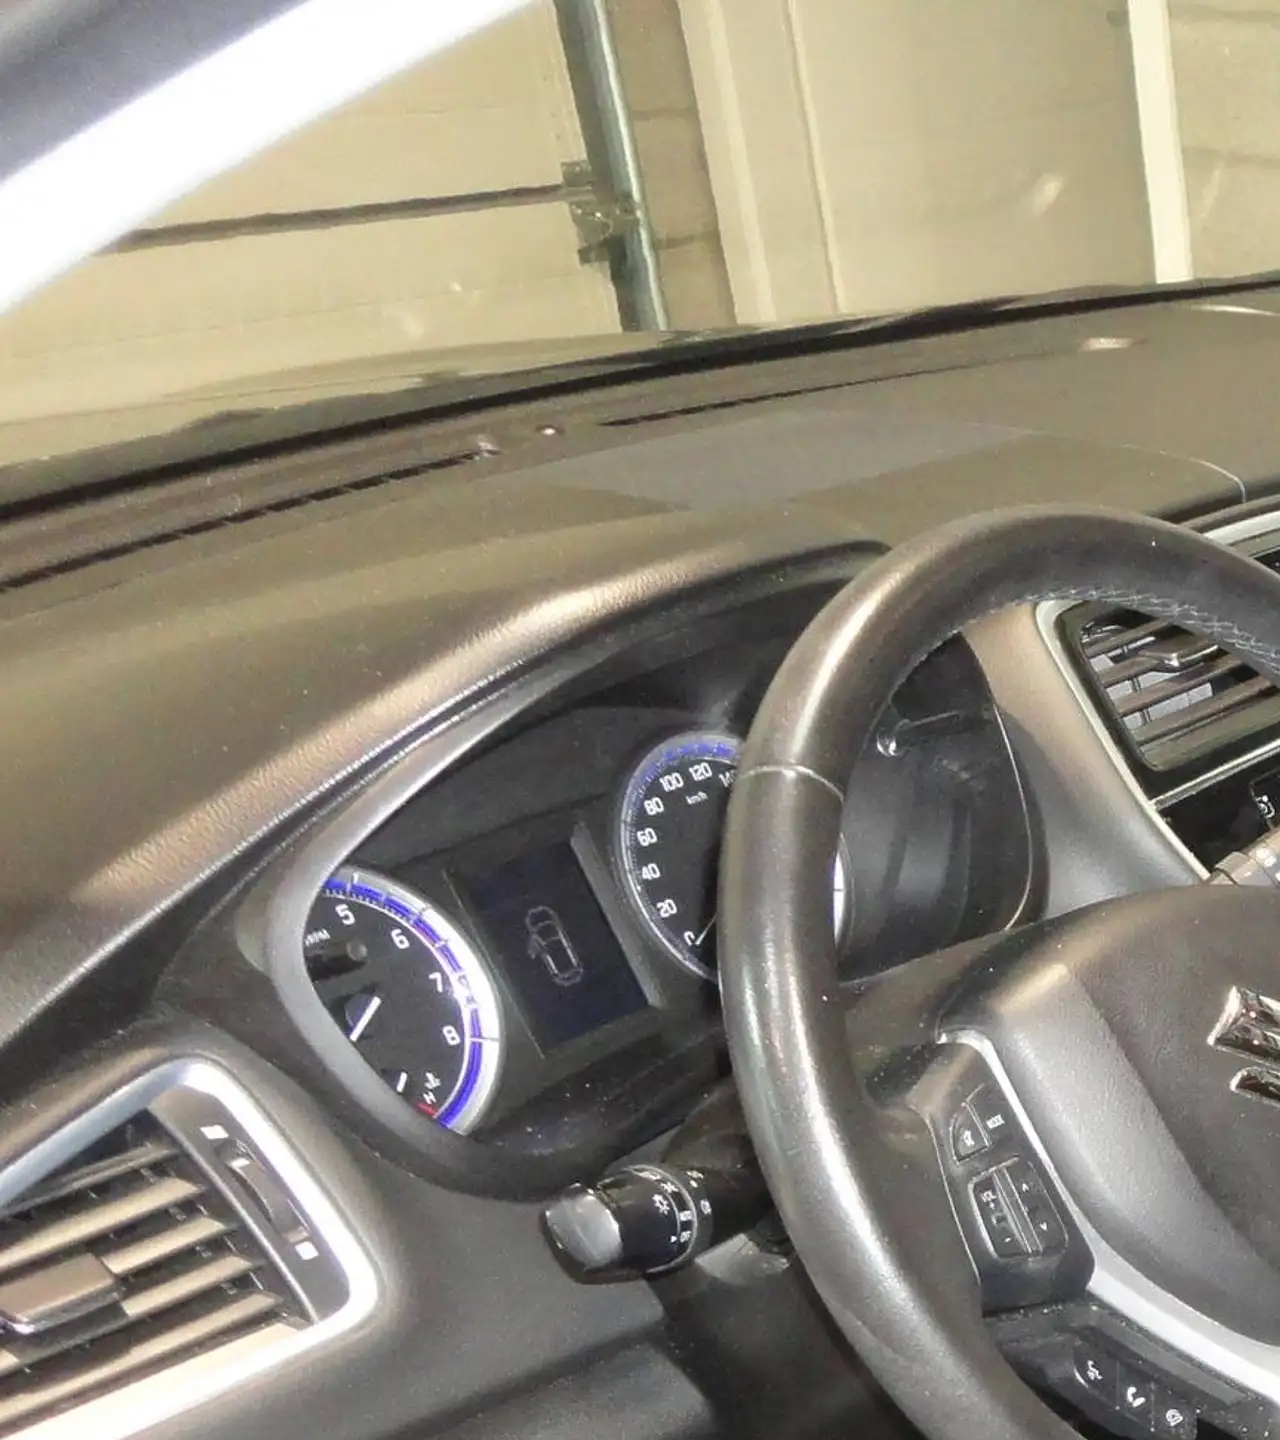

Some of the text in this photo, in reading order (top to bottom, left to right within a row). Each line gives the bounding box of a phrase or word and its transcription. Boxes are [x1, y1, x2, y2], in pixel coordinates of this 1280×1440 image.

[688, 762, 714, 781] 120
[659, 772, 684, 792] 100
[643, 797, 665, 815] 80
[636, 827, 657, 847] 60
[641, 863, 661, 880] 40
[335, 904, 355, 925] 5
[656, 899, 677, 918] 20
[390, 929, 410, 949] 6
[429, 971, 443, 993] 7
[442, 1024, 461, 1046] 8
